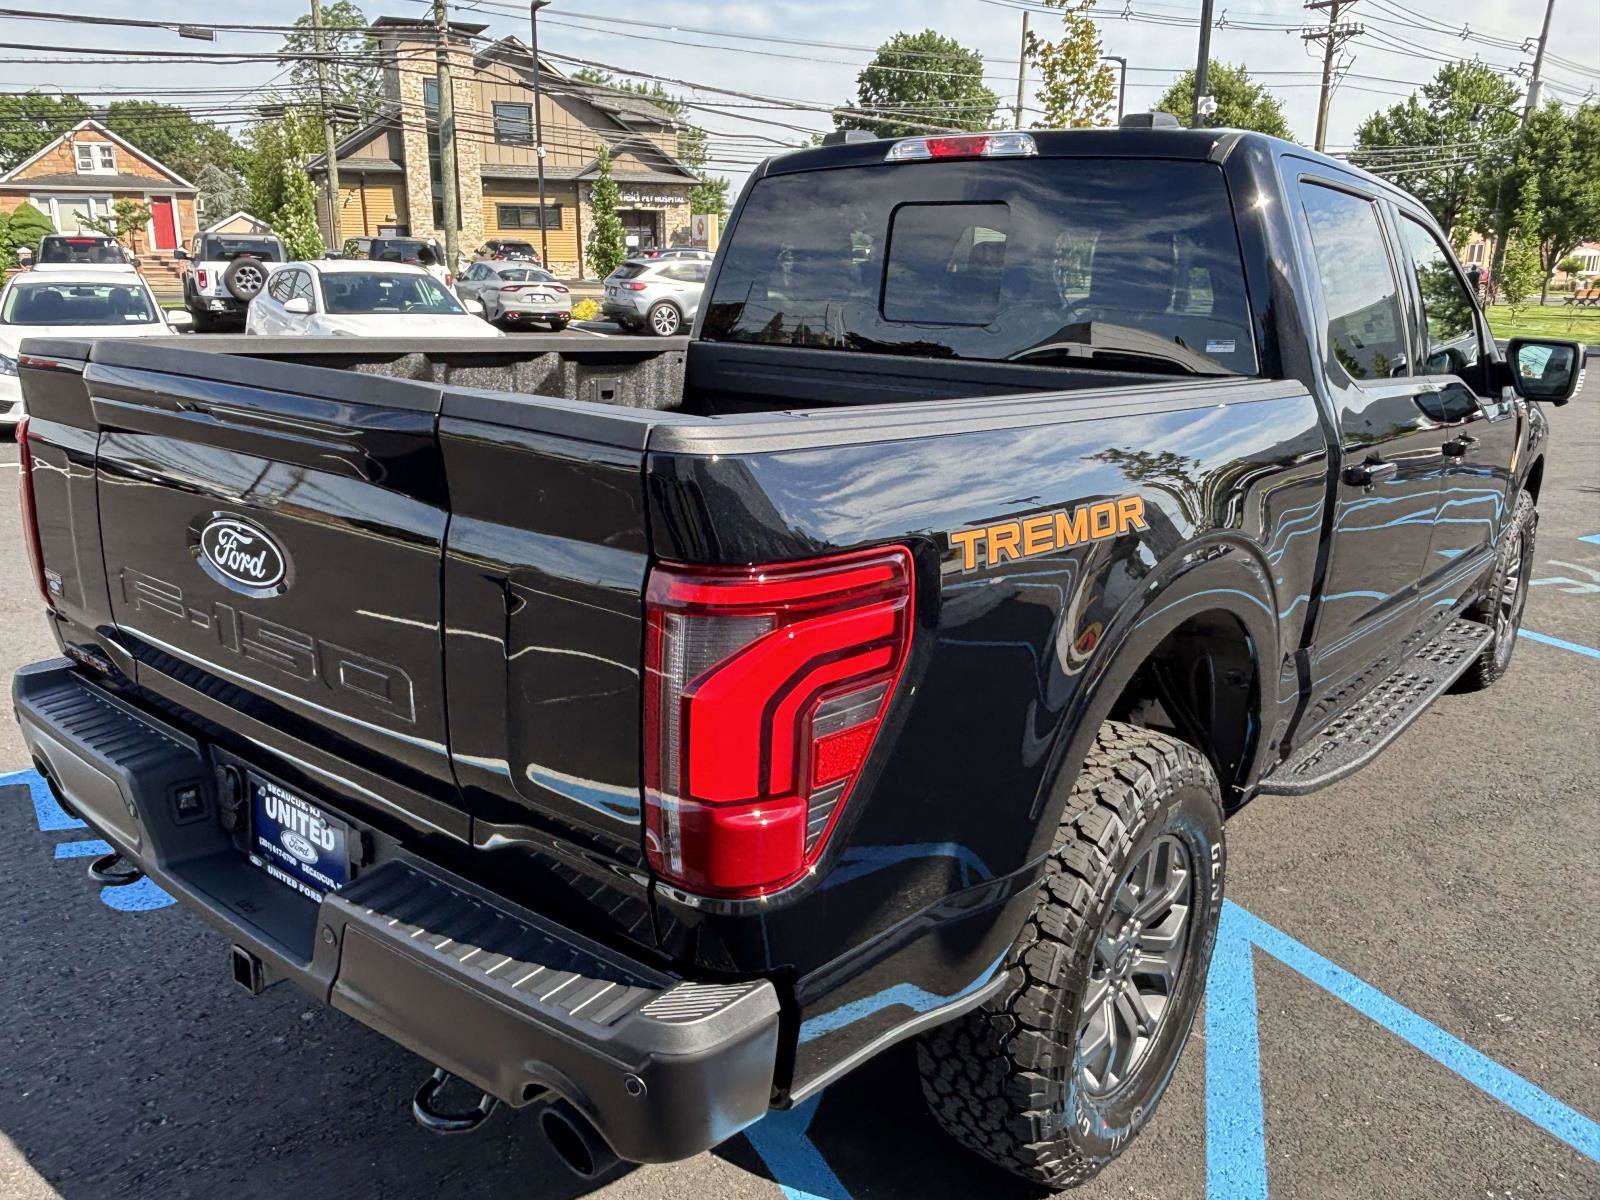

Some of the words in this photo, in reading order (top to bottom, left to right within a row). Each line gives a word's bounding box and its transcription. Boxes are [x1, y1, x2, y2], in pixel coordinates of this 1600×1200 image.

[654, 195, 685, 203] HOSPITAL
[213, 526, 269, 580] Ford
[950, 495, 1148, 571] TREMOR
[121, 566, 417, 724] F-150
[264, 796, 335, 851] UNITED
[286, 834, 312, 859] Ford
[267, 865, 298, 889] UNITED
[298, 883, 323, 904] FORD
